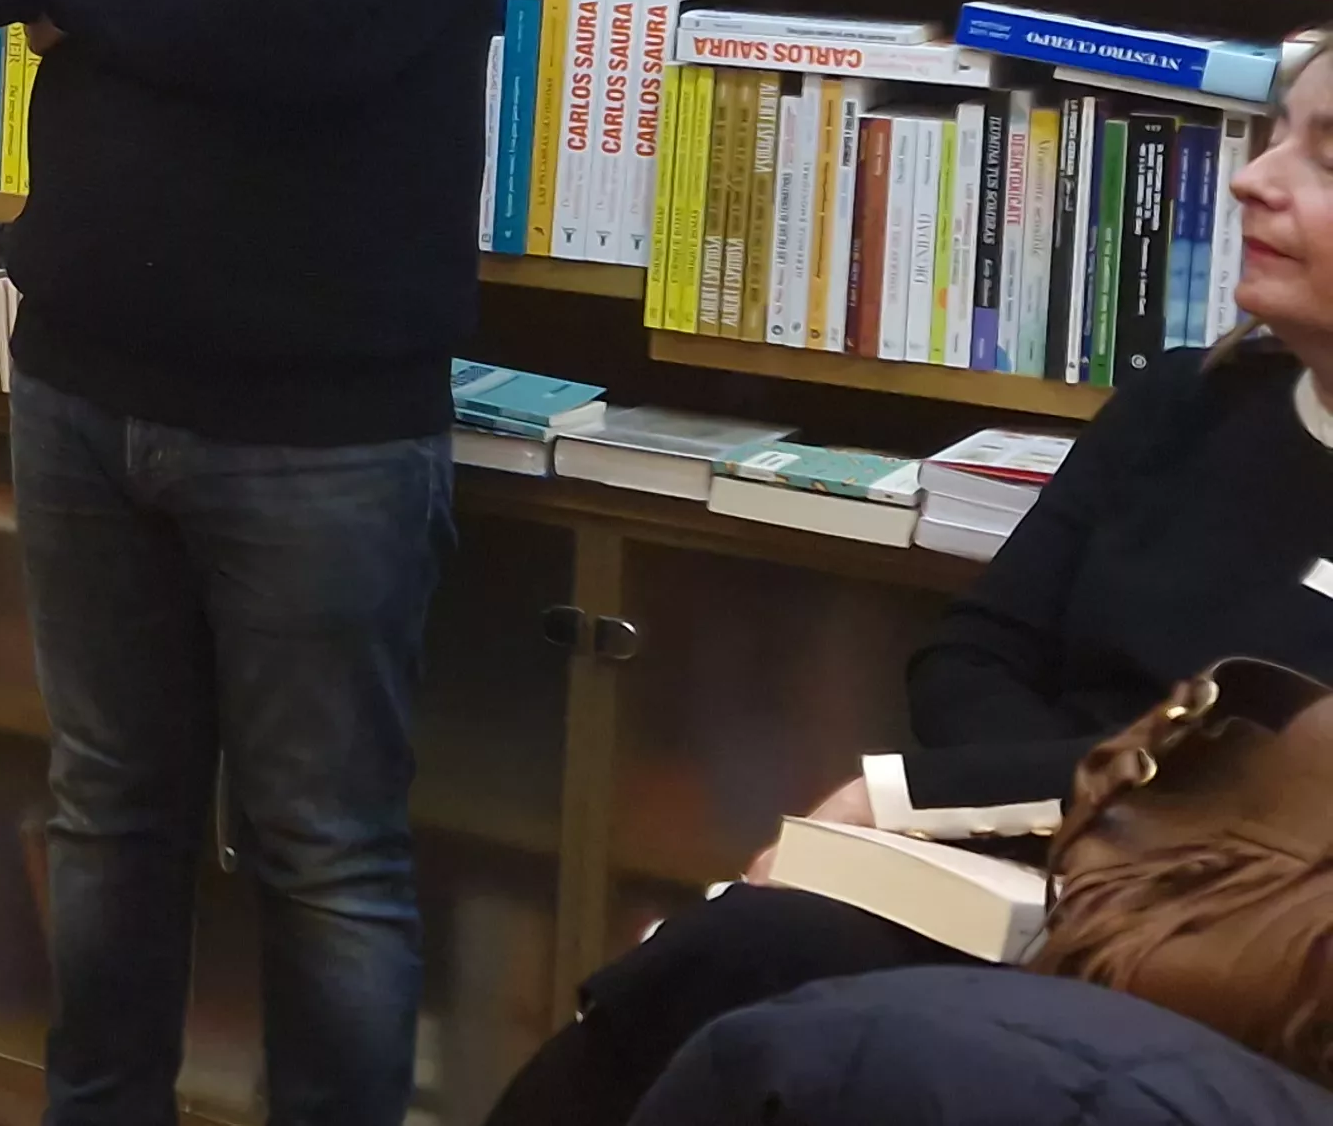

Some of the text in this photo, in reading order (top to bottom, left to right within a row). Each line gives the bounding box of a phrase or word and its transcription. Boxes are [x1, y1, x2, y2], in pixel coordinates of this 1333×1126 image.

[566, 0, 599, 152] CARLOS SAURA
[600, 3, 634, 154] CARLOS SAURA
[635, 5, 668, 157] CARLOS SAURA
[692, 36, 863, 70] CARLOS SAURA
[1024, 30, 1183, 72] NUESTRO CUERPO
[985, 167, 997, 191] TUS
[912, 213, 933, 285] DIGNIDAD
[982, 190, 997, 246] SOMBRAS
